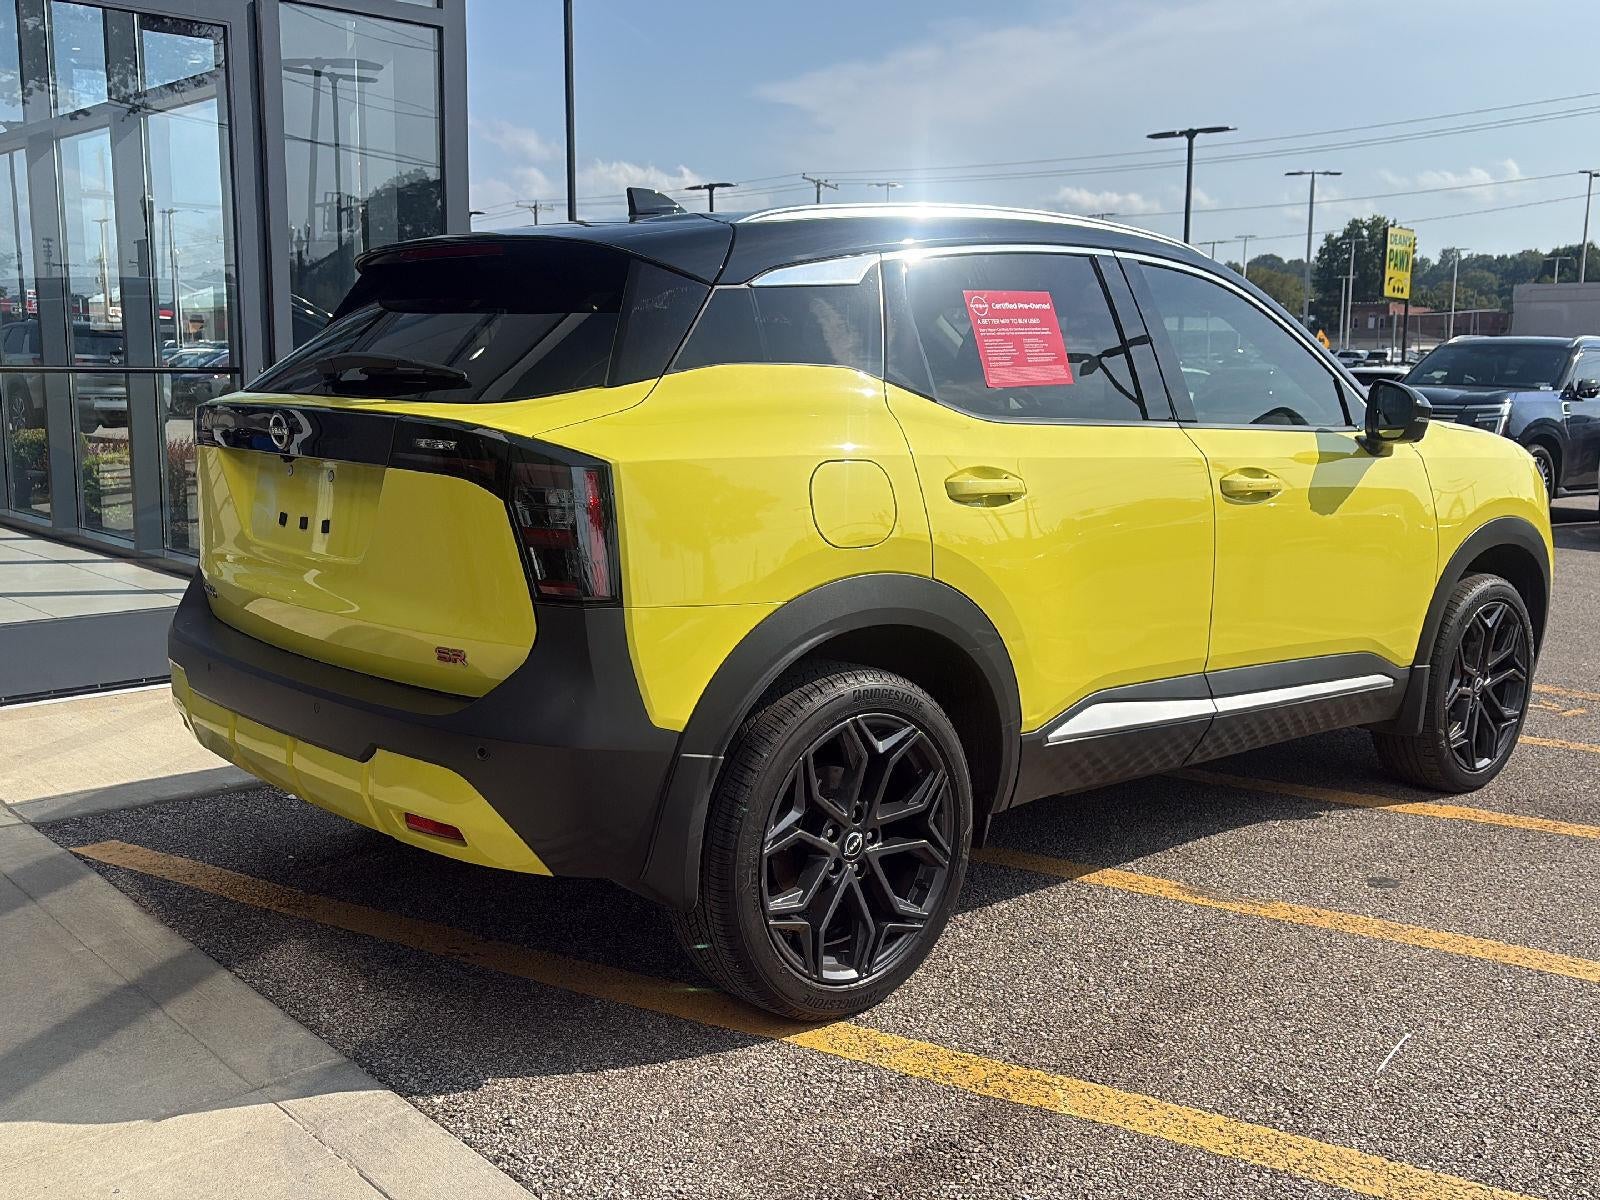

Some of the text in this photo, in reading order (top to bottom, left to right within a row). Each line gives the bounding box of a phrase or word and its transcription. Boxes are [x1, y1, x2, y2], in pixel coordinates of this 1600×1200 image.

[1390, 233, 1413, 247] DEAN'S
[1388, 249, 1410, 273] PAWN
[435, 646, 467, 666] SR
[852, 688, 925, 709] BRIDGESTONE
